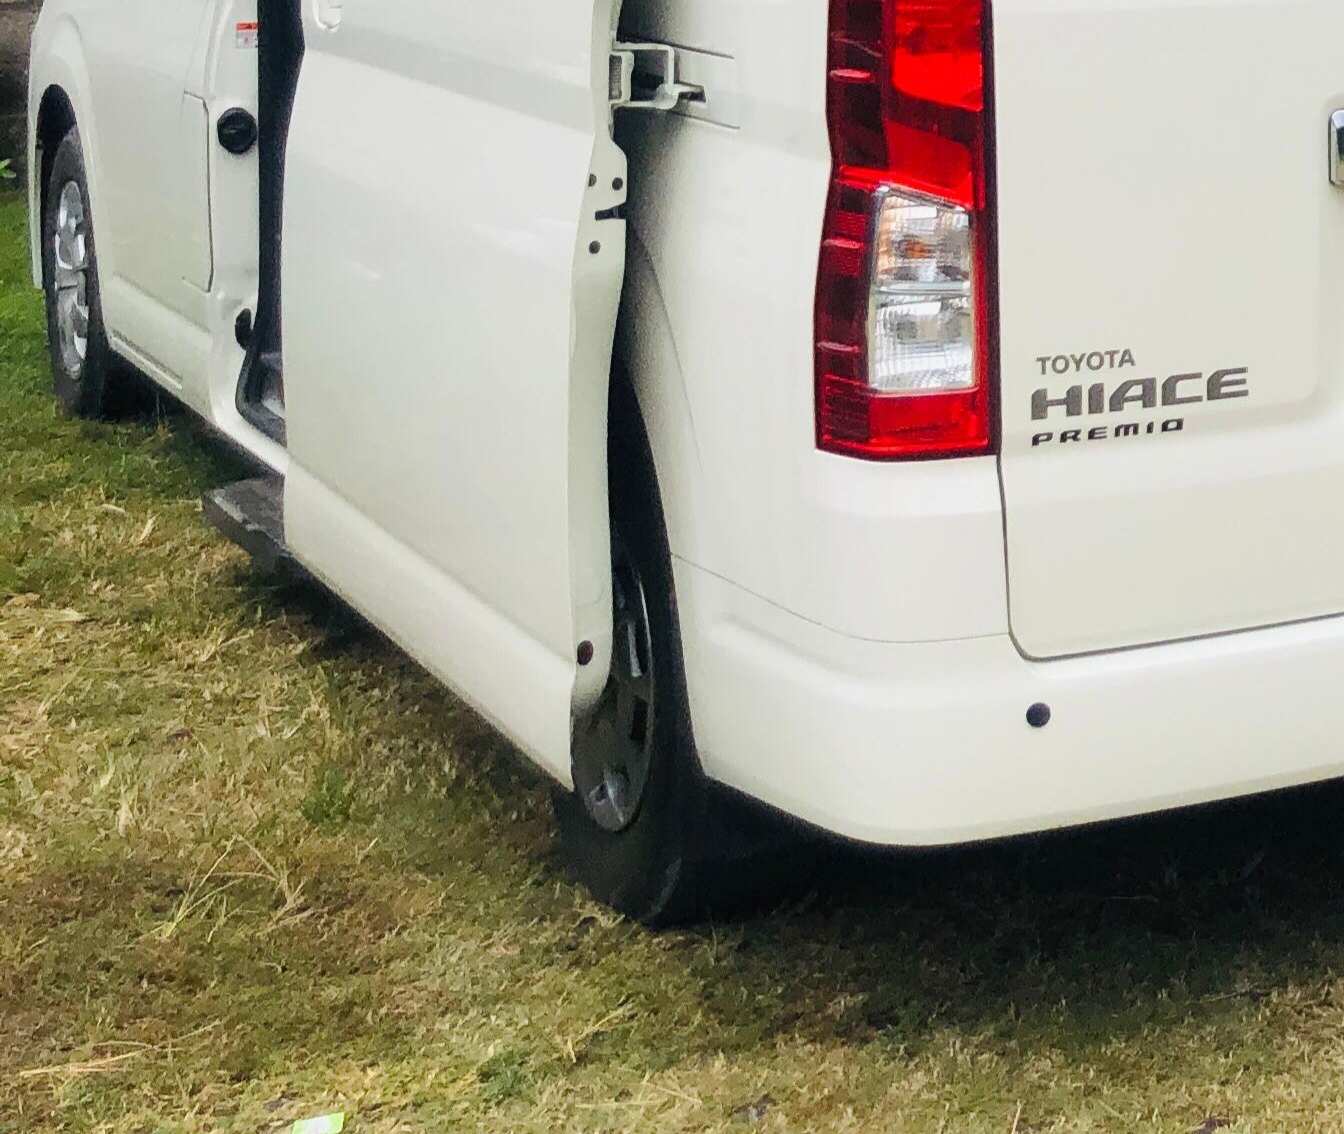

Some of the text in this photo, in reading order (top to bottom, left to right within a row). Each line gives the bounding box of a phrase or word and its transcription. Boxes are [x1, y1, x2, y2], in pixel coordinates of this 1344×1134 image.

[1036, 348, 1137, 375] TOYOTA
[1031, 366, 1250, 420] HIACE
[1031, 417, 1185, 446] PREMIO
